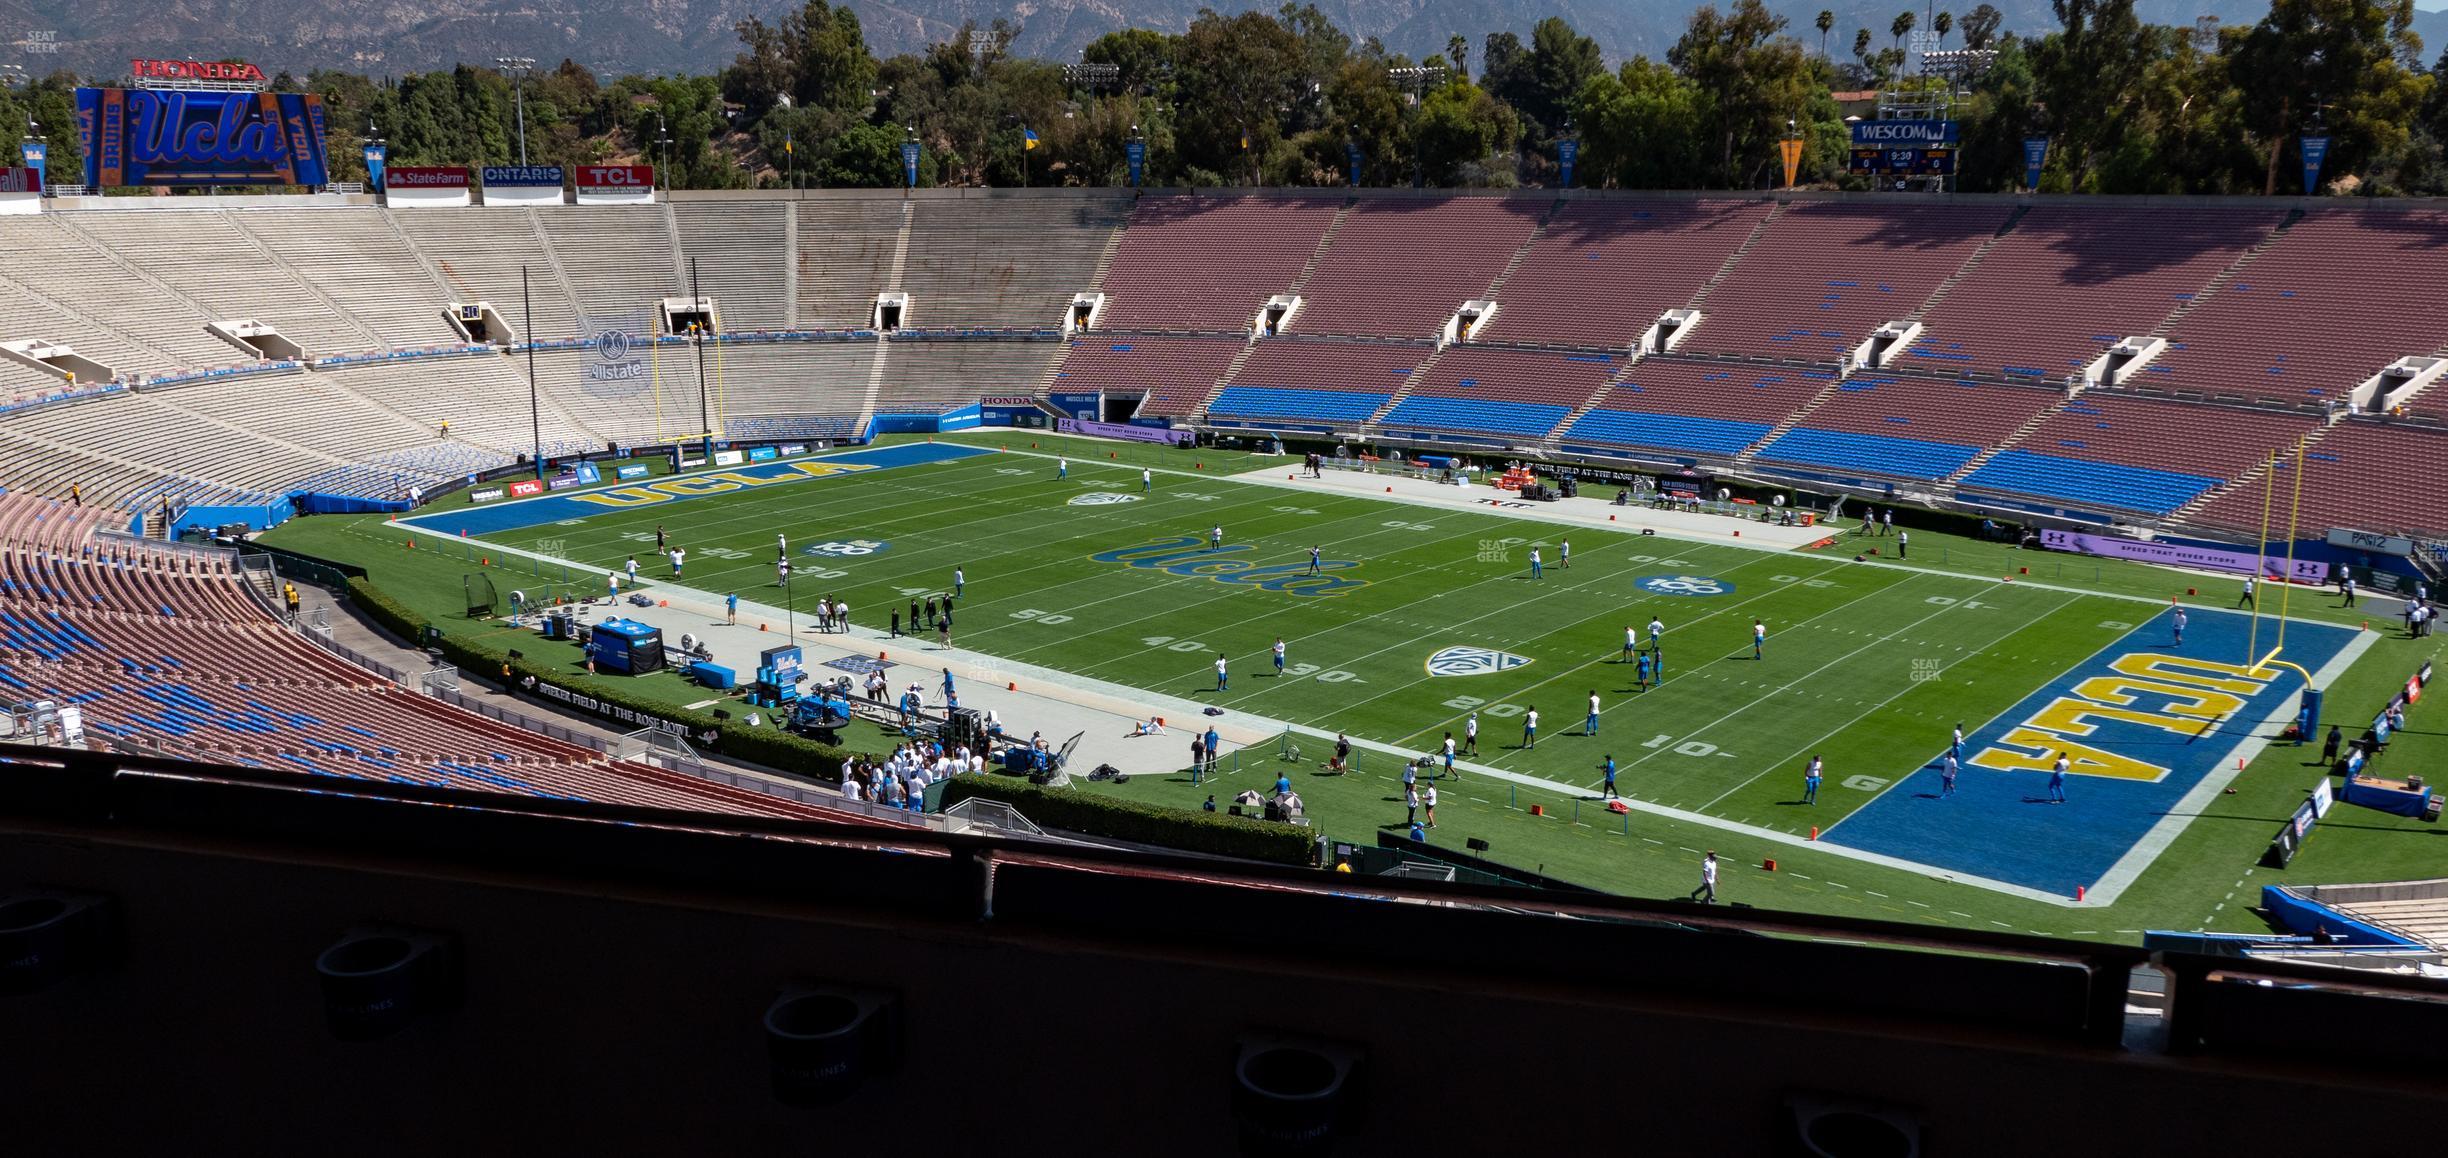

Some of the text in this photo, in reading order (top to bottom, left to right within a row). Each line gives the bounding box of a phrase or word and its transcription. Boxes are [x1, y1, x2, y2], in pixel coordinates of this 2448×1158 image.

[131, 59, 267, 79] HONDA
[129, 92, 288, 163] Ucla
[1862, 125, 1926, 139] WESCOM
[104, 104, 121, 169] BRUINS
[288, 115, 311, 160] UCLA
[1863, 160, 1869, 168] 0
[1891, 152, 1912, 160] 9:30
[1933, 160, 1939, 168] 0
[590, 168, 640, 184] TCL
[983, 397, 1032, 405] HONDA
[1556, 465, 1579, 475] FIELD
[1581, 468, 1591, 476] AT
[1592, 470, 1611, 479] THE
[1612, 472, 1632, 481] ROSE
[514, 483, 539, 494] TCL
[566, 461, 880, 507] UCLA
[472, 489, 503, 499] NISSAN
[812, 542, 874, 555] 100
[2121, 545, 2147, 553] SPEED
[2176, 552, 2204, 561] NEVER
[2208, 555, 2236, 564] STOPS
[791, 566, 849, 579] 30
[1087, 536, 1374, 597] Ucla
[1646, 578, 1723, 594] 100
[1009, 608, 1074, 624] 50
[1140, 636, 1207, 652] 40
[1283, 663, 1357, 683] 30
[539, 682, 691, 737] SPIEKER FIELD AT THE ROSE BOWL
[1441, 695, 1526, 718] 20
[1965, 652, 2285, 783] UCLA
[1641, 734, 1719, 758] 10
[1842, 774, 1891, 792] G
